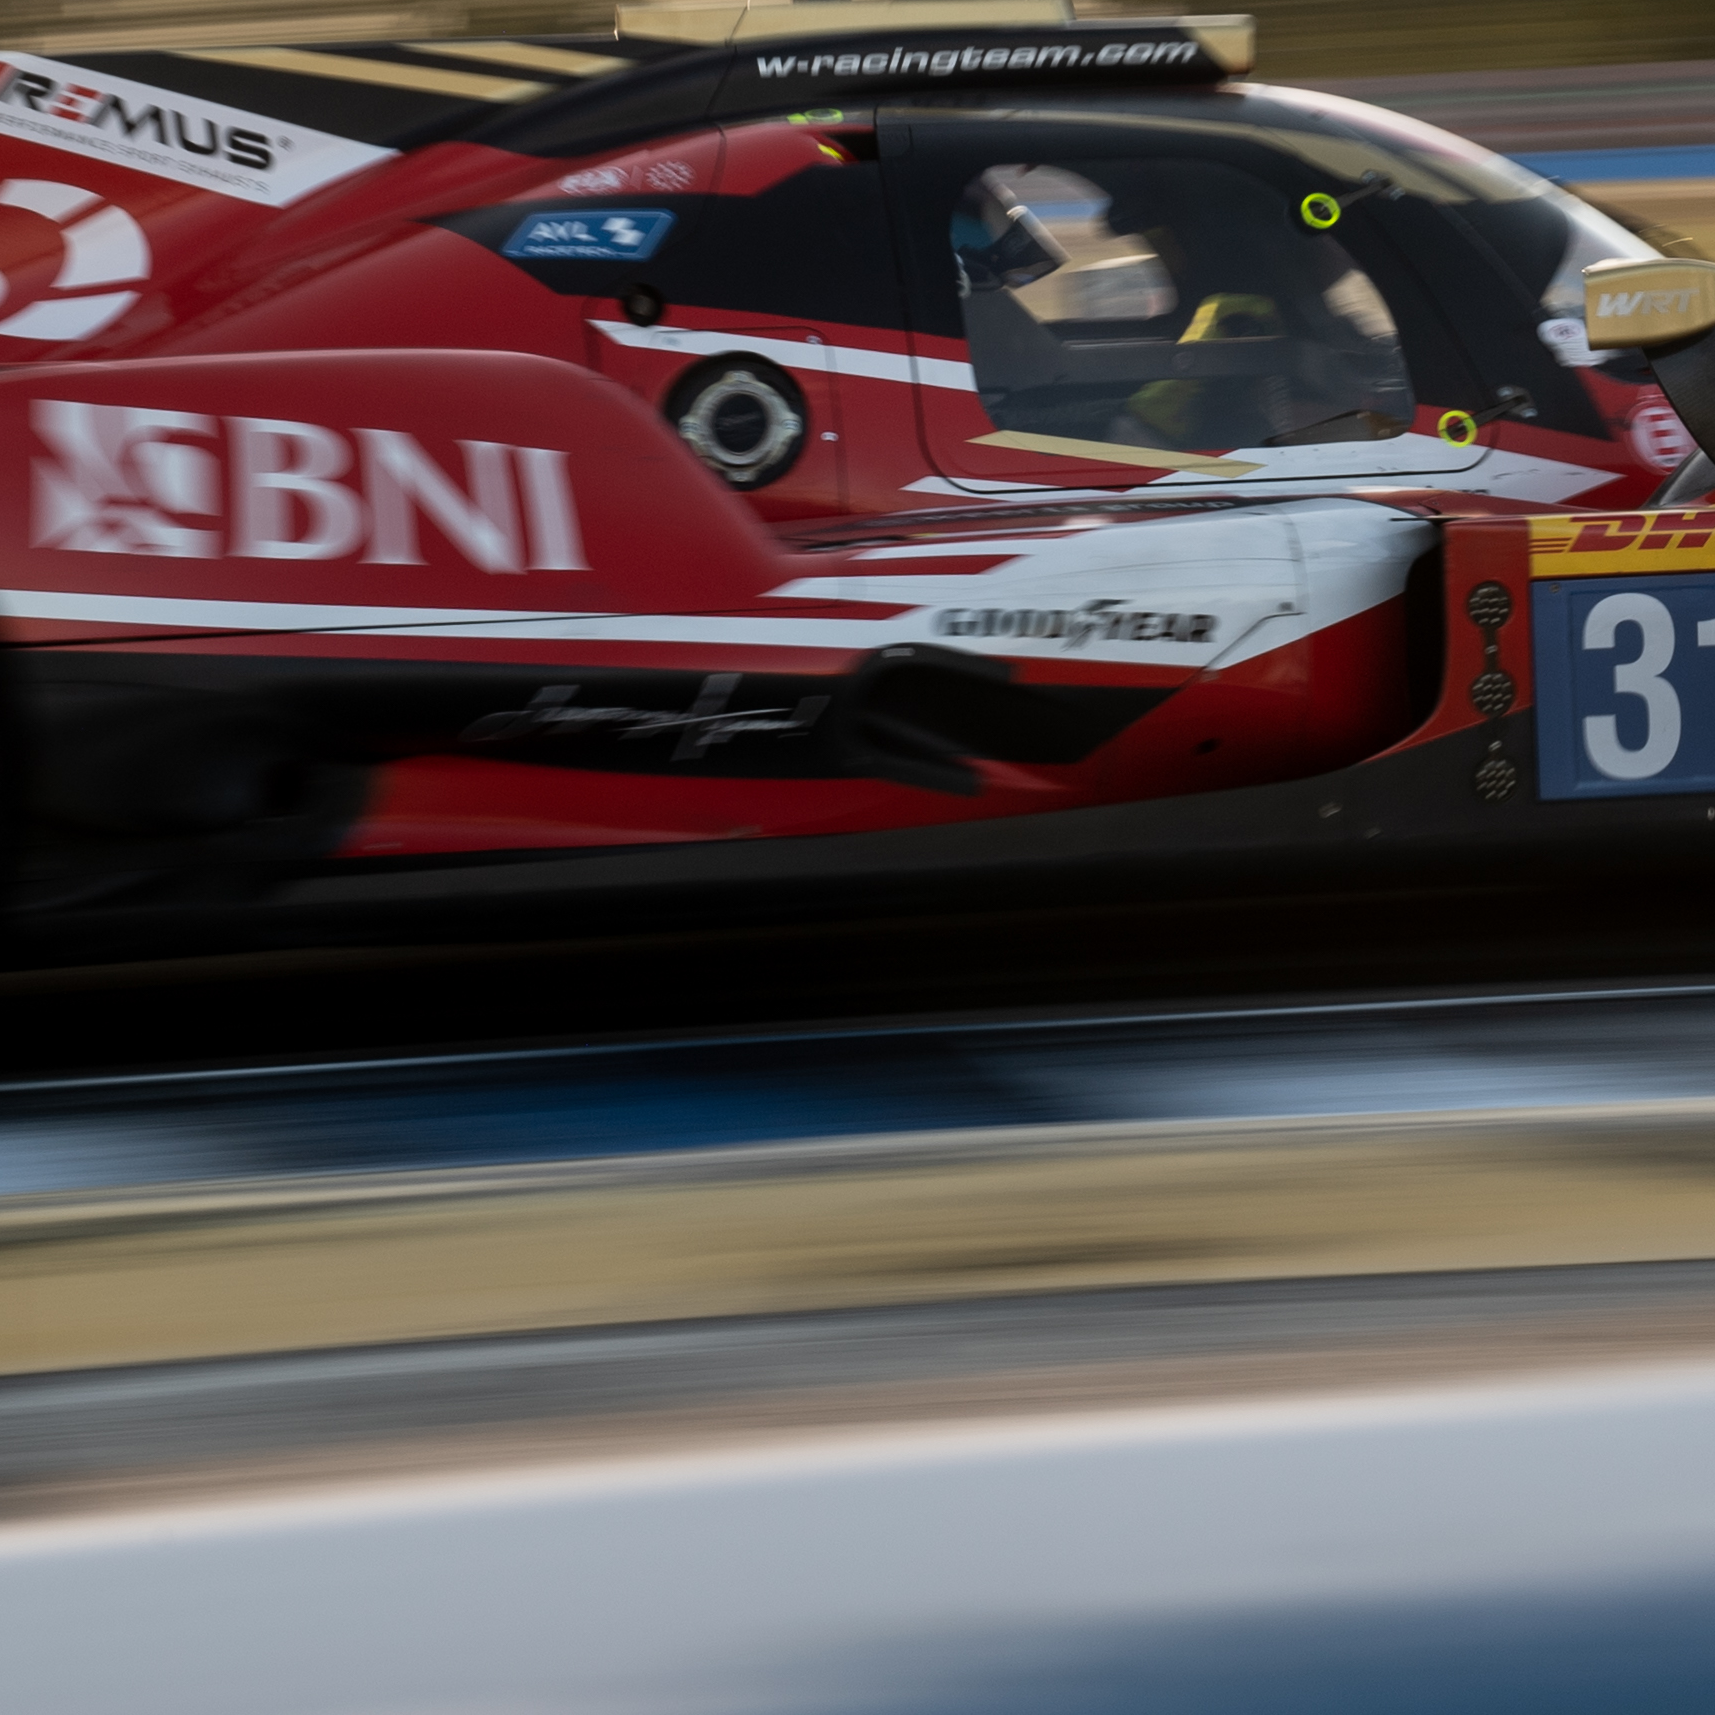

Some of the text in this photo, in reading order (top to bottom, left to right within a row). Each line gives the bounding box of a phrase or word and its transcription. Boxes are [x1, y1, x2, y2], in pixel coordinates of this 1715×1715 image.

[757, 42, 1198, 78] w-racingteam.com
[1596, 287, 1700, 318] WRT
[224, 414, 593, 575] BNI
